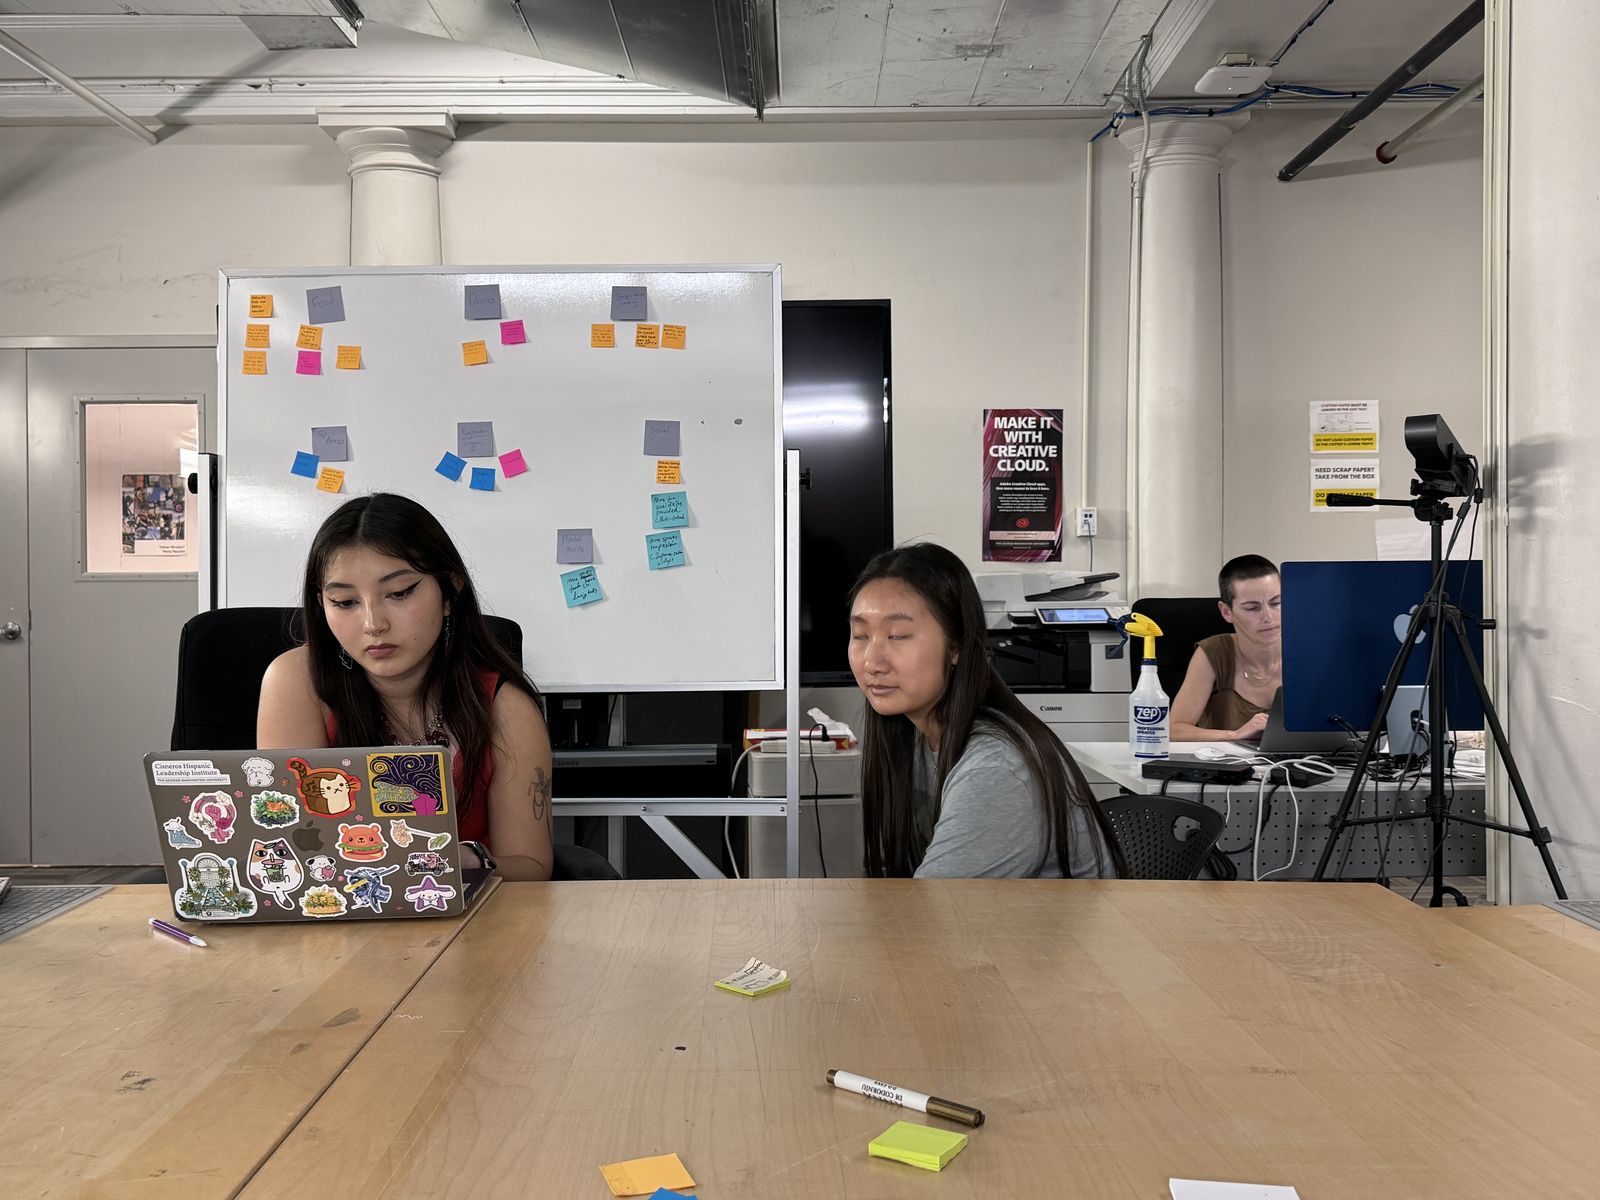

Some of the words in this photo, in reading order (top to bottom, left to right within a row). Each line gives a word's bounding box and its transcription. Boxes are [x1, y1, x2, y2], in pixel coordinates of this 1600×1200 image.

[994, 416, 1036, 428] MAKE
[1040, 416, 1054, 428] IT
[1004, 431, 1042, 443] WITH
[990, 446, 1057, 457] CREATIVE
[997, 459, 1049, 471] CLOUD.
[183, 762, 211, 770] Hispanic
[895, 1094, 903, 1102] DE
